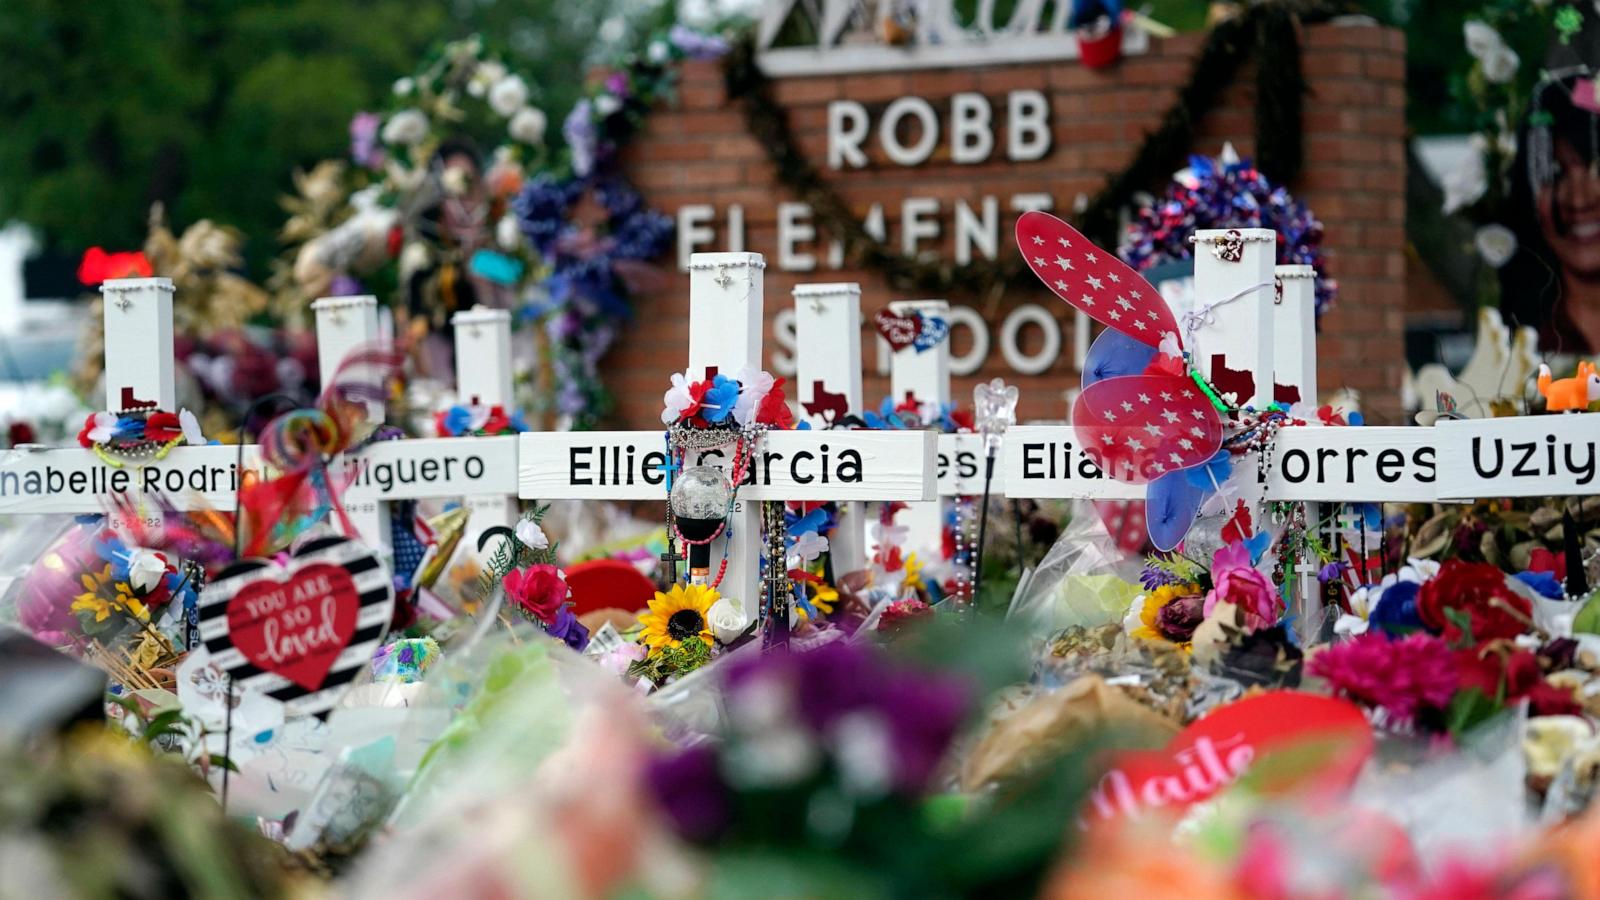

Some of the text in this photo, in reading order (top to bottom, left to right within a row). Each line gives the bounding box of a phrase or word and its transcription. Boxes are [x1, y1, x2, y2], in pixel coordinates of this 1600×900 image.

[827, 89, 1053, 170] ROBB
[0, 465, 127, 496] nabelle
[344, 455, 485, 492] ilguero
[569, 444, 665, 486] Ellie
[1472, 434, 1596, 485] Uziy
[246, 573, 333, 619] YOU ARE
[281, 604, 312, 630] SO
[256, 595, 341, 664] loved
